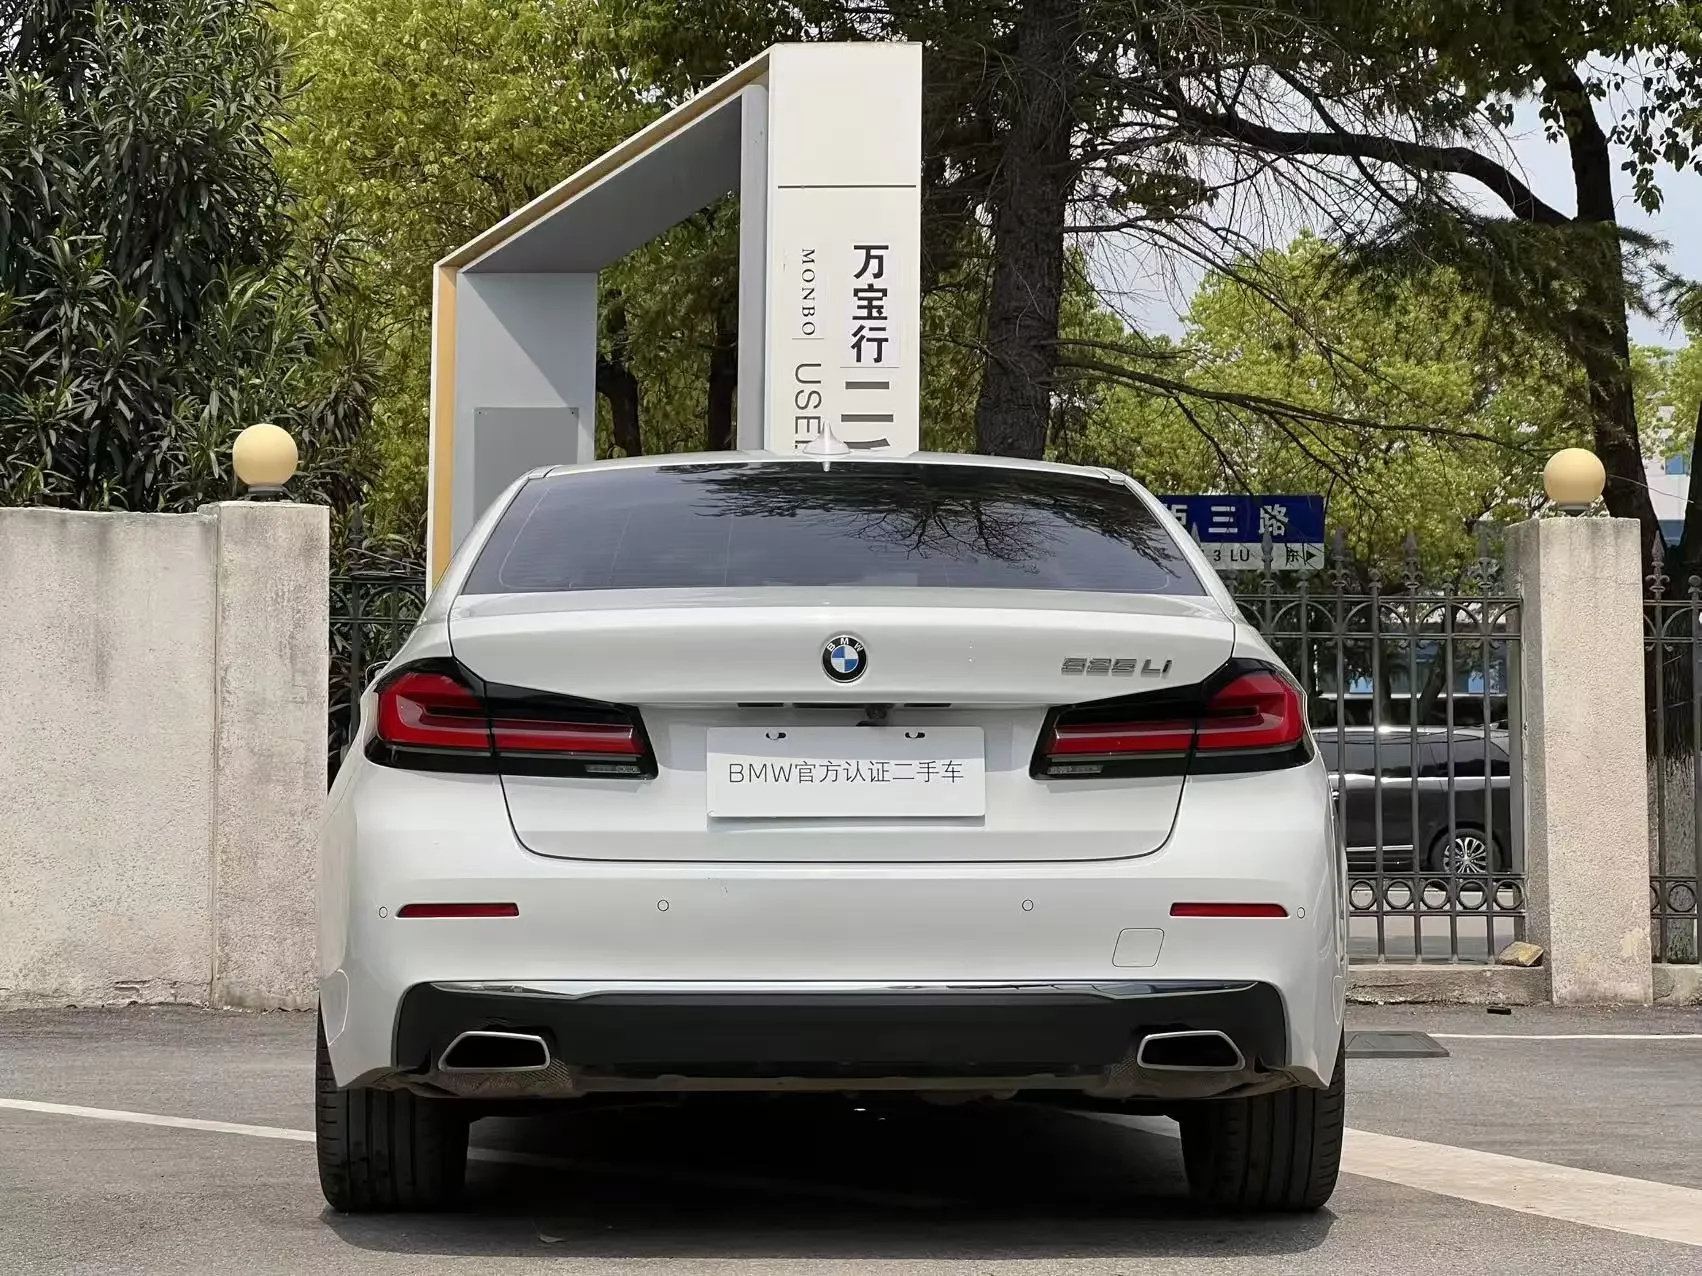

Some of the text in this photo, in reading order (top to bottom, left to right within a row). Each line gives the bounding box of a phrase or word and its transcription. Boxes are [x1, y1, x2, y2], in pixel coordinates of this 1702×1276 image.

[794, 248, 822, 449] MONBO USE
[841, 244, 894, 449] 万宝行 二
[1230, 549, 1250, 562] LU
[827, 637, 864, 652] BMW
[728, 760, 964, 783] BMW官方认证二手车
